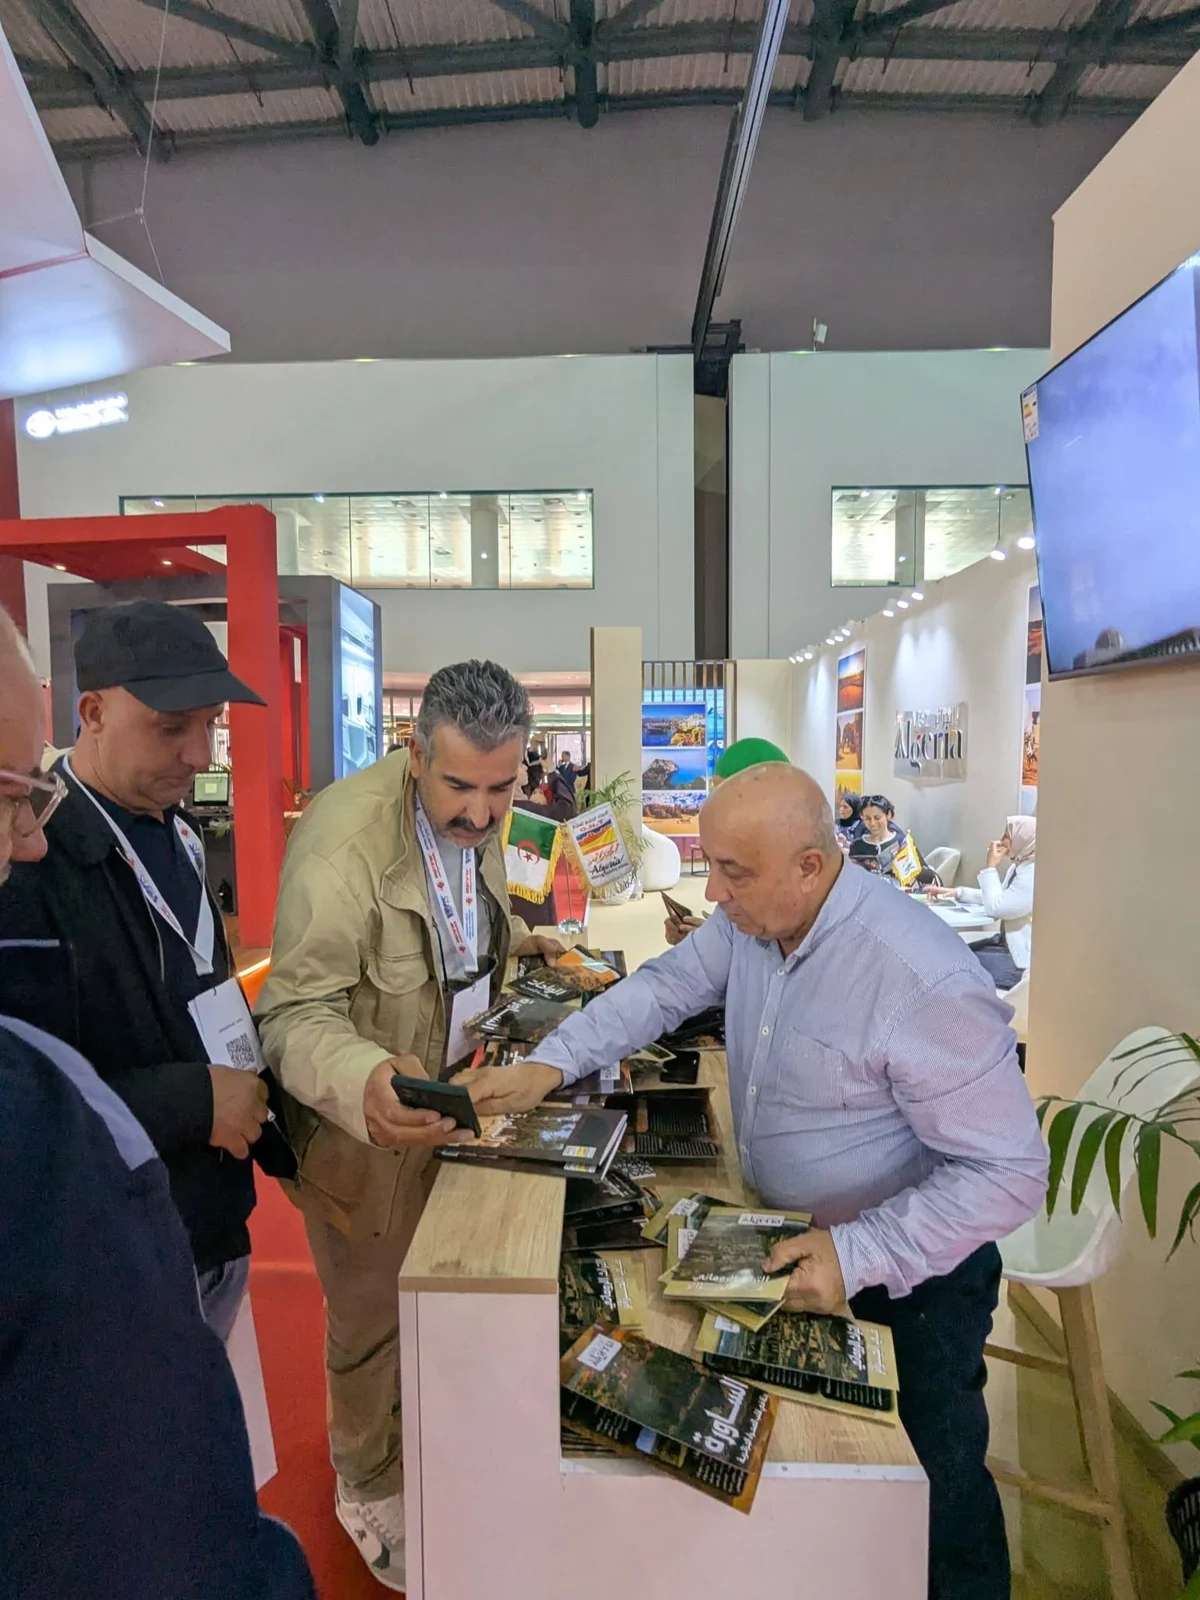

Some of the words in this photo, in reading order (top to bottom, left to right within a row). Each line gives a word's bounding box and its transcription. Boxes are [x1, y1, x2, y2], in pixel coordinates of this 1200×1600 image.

[895, 720, 962, 775] Algeria
[589, 855, 624, 876] Algeria
[692, 1374, 749, 1455] الساورة
